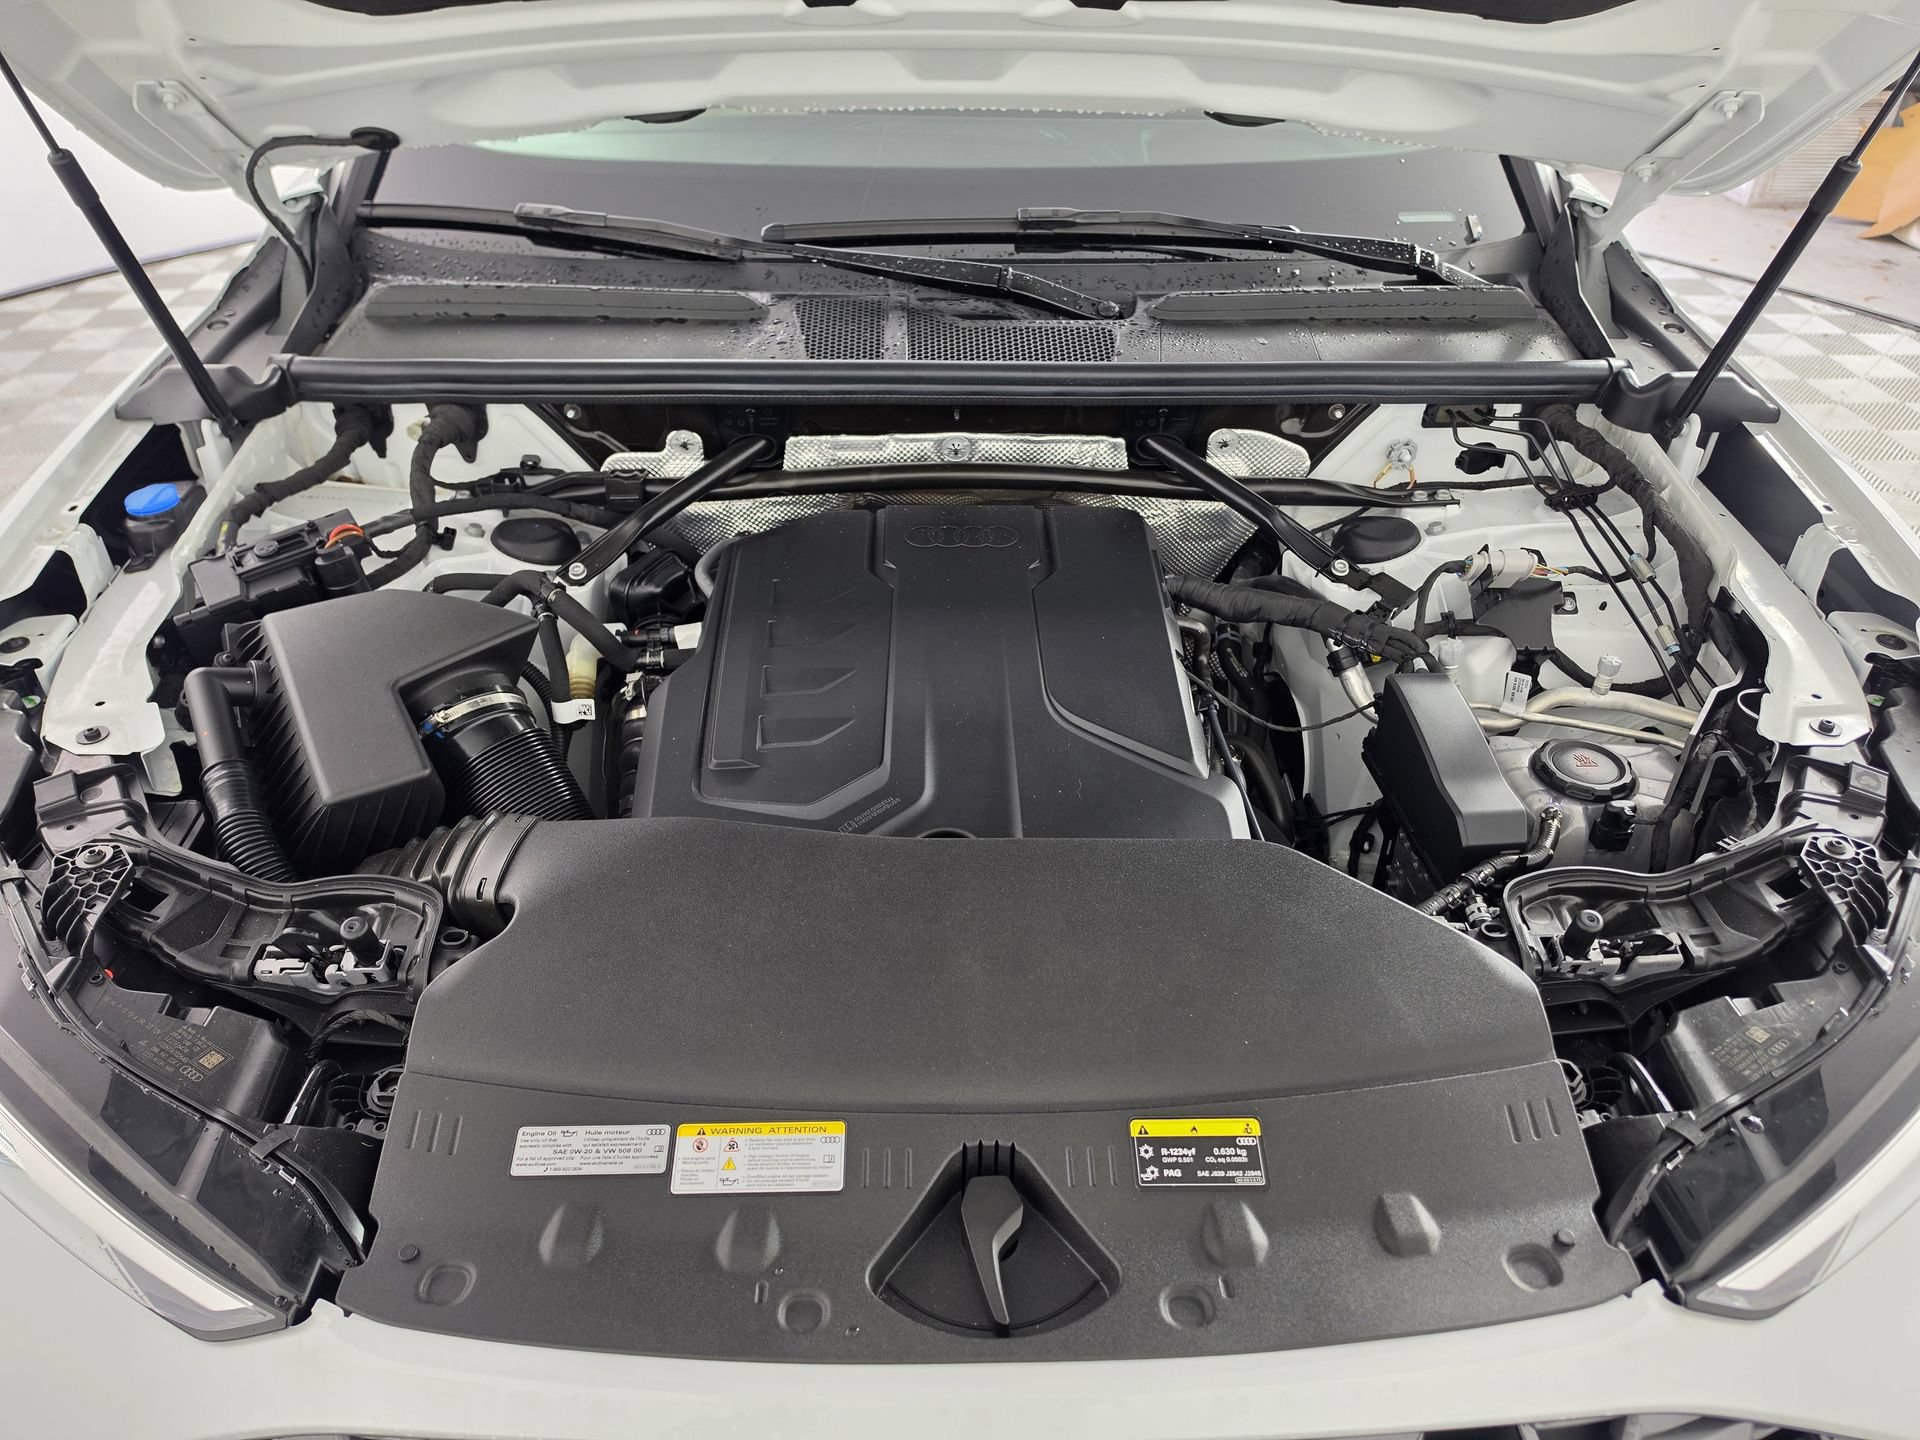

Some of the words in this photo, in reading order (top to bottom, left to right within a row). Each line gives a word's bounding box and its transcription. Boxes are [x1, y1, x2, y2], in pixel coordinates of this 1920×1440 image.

[711, 1126, 763, 1135] WARNING
[768, 1125, 827, 1134] ATTENTION
[1160, 1147, 1196, 1157] R-1234yf
[1236, 1147, 1248, 1157] kg
[1161, 1156, 1178, 1164] GWP
[1163, 1168, 1183, 1178] PAG
